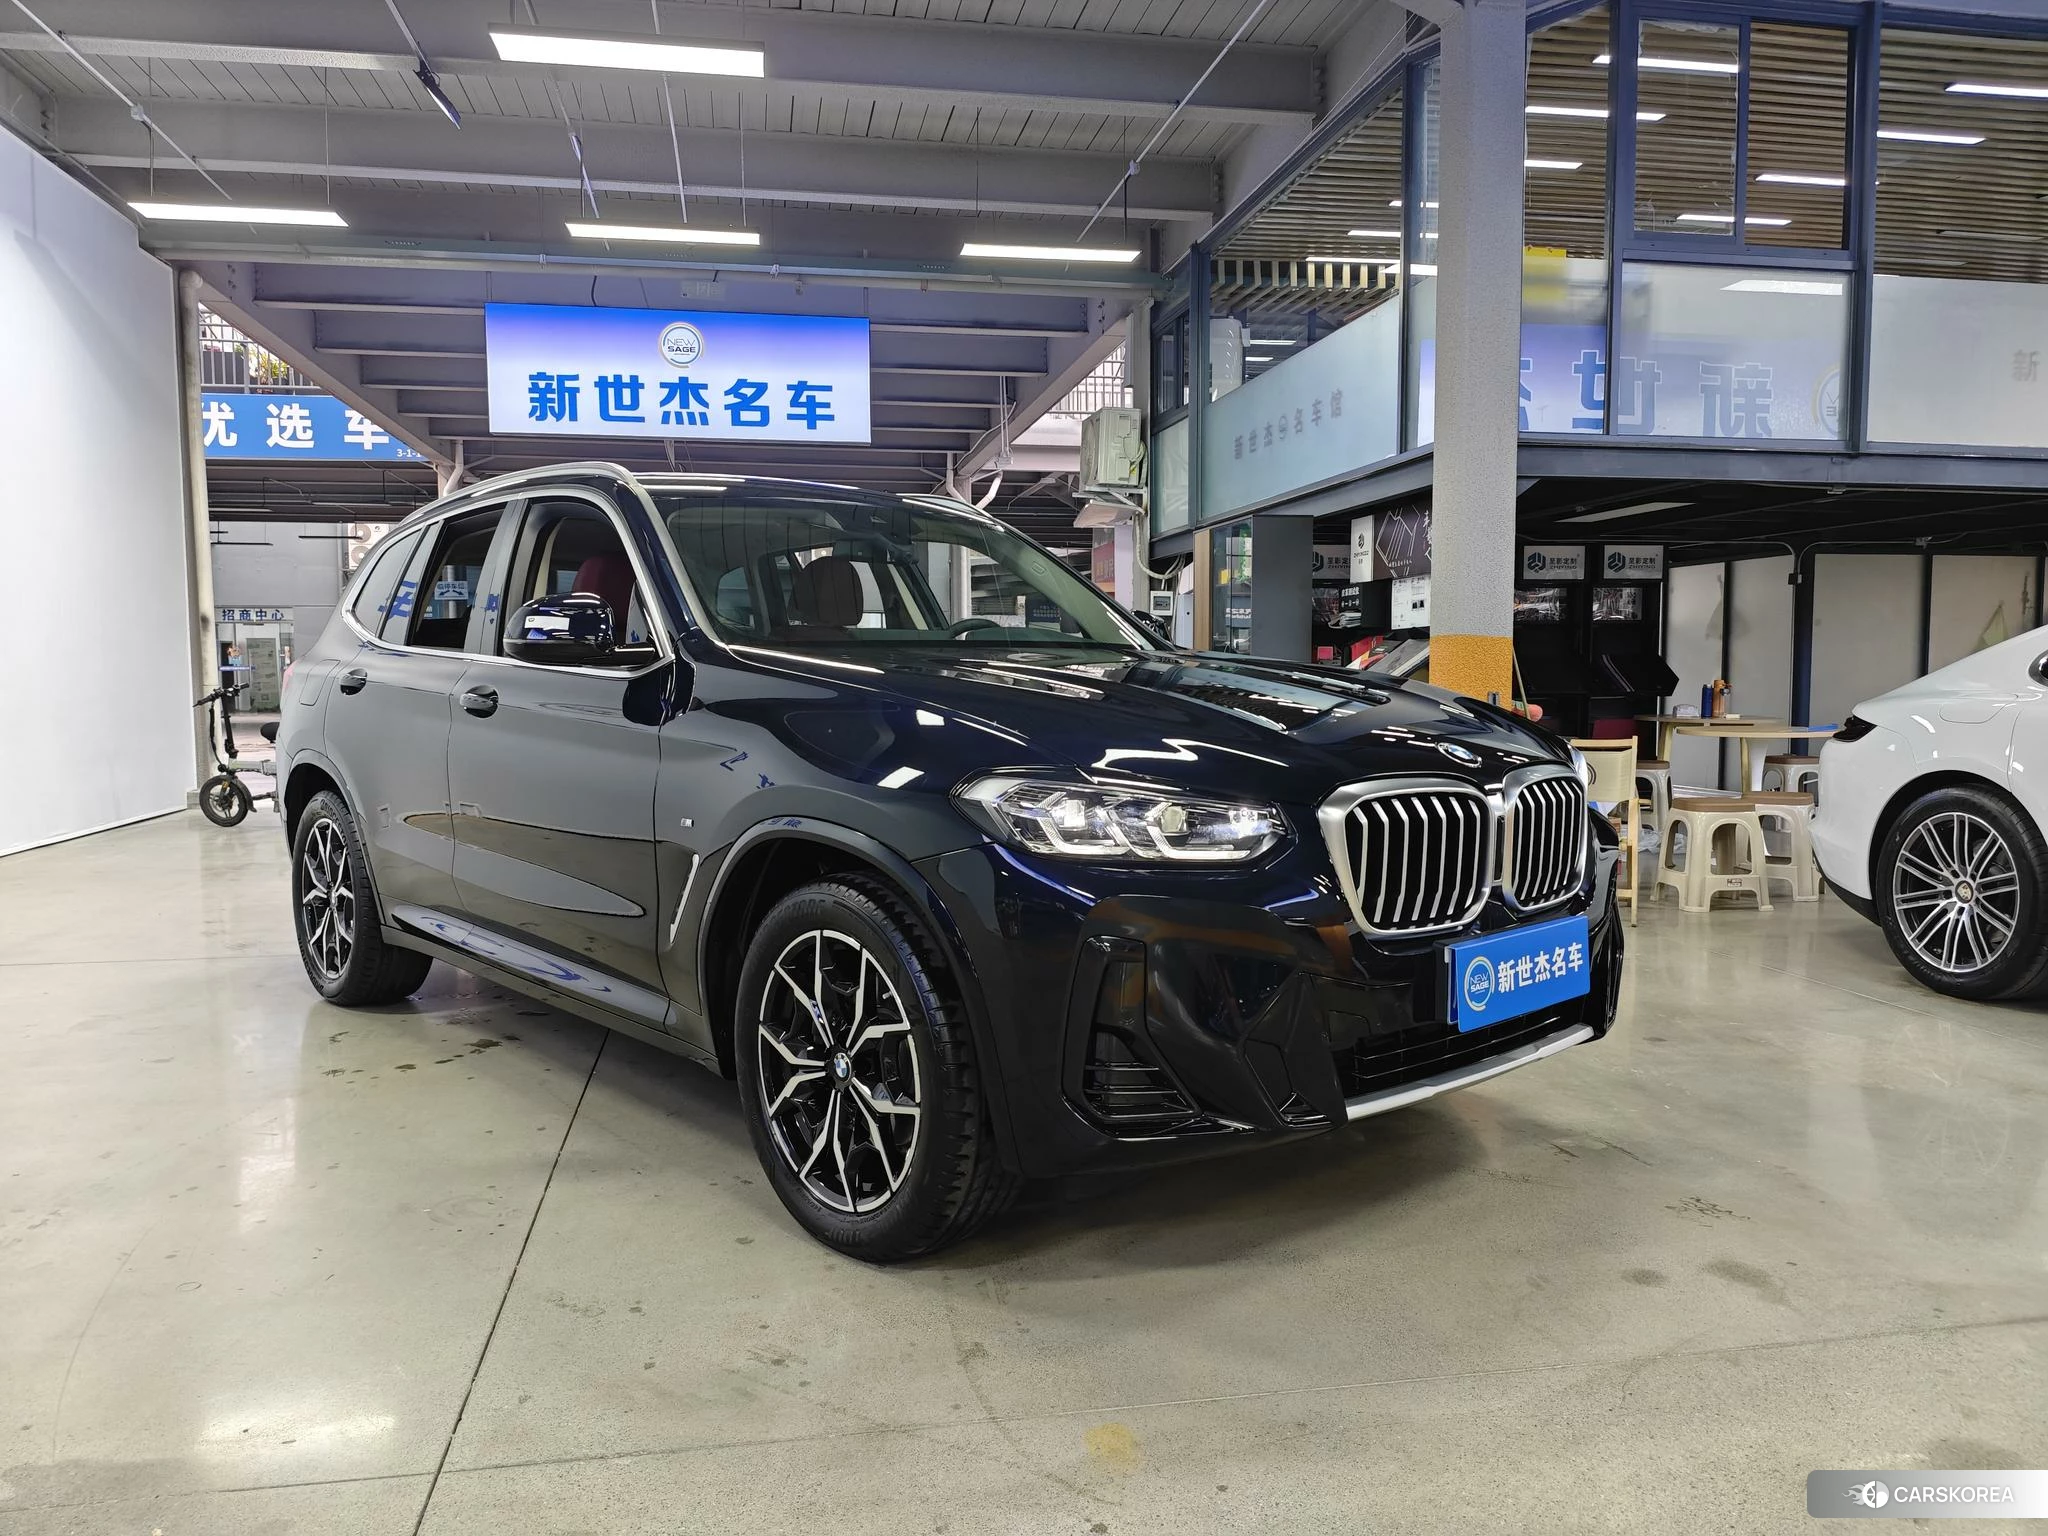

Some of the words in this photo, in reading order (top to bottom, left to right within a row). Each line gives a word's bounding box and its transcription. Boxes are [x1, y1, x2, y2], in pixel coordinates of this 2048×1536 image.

[667, 338, 696, 346] NEW
[528, 371, 835, 430] 新世杰名车
[202, 401, 390, 451] 优选车
[222, 608, 284, 621] 招商中心
[1497, 942, 1583, 993] 新世杰名车
[1469, 972, 1489, 984] NEW
[1470, 981, 1490, 993] SAGE
